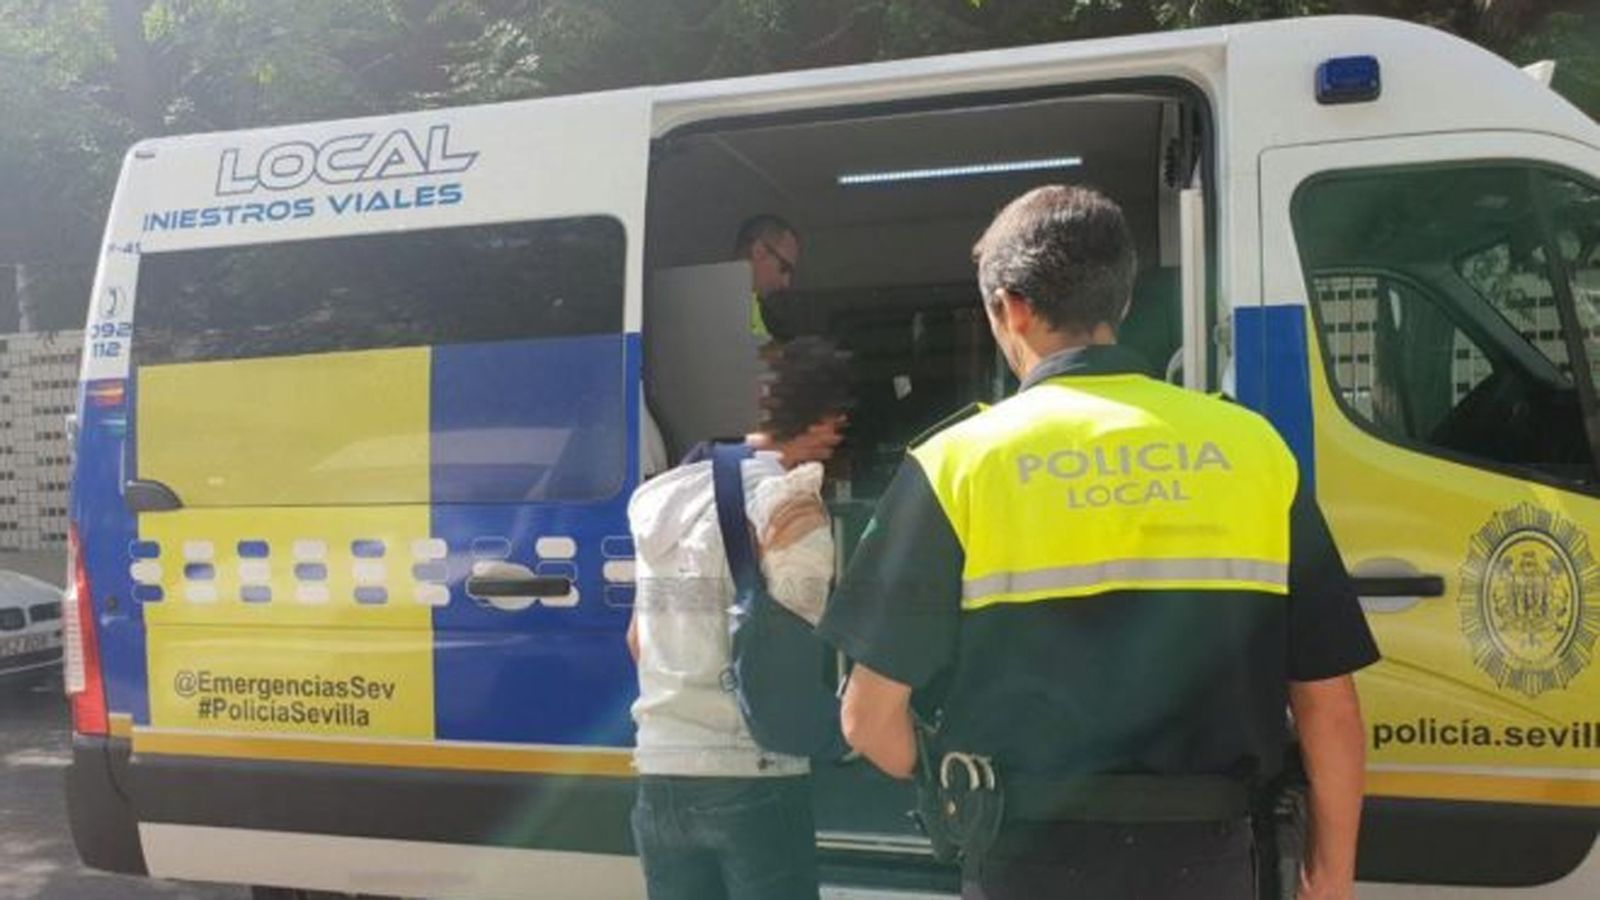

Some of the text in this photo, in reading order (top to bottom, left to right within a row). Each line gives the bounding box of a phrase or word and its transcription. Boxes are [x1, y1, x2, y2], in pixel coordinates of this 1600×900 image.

[215, 125, 480, 196] LOCAL
[329, 183, 463, 216] VIALES
[1017, 441, 1232, 483] POLICIA
[1067, 480, 1191, 509] LOCAL
[174, 670, 396, 700] @EmergenciasSev
[198, 699, 370, 727] #PoliciaSevilla
